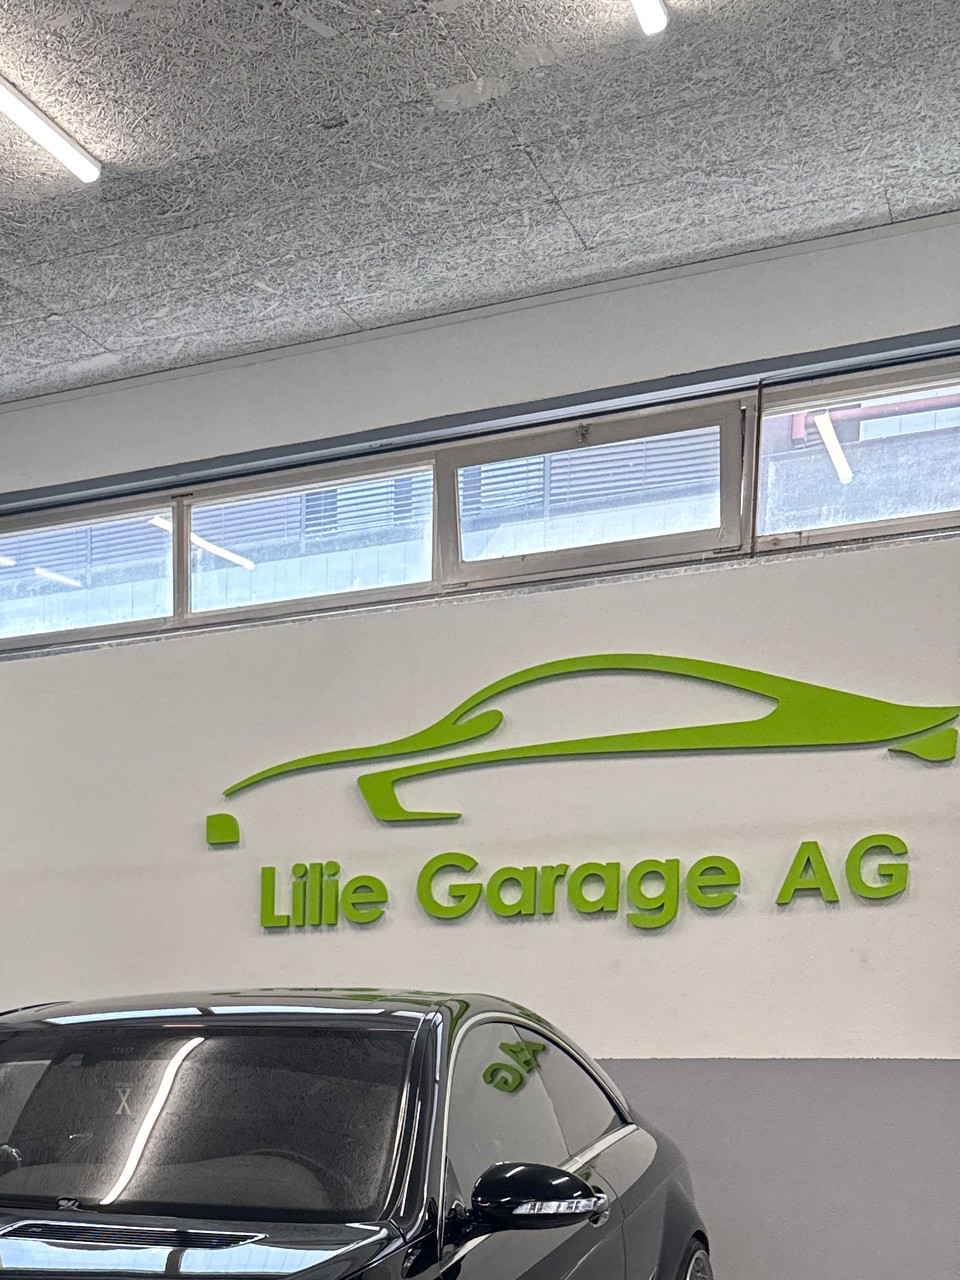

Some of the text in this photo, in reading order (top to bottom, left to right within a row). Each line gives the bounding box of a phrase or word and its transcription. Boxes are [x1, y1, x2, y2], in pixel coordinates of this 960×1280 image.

[260, 833, 909, 930] Lilie Garage AG
